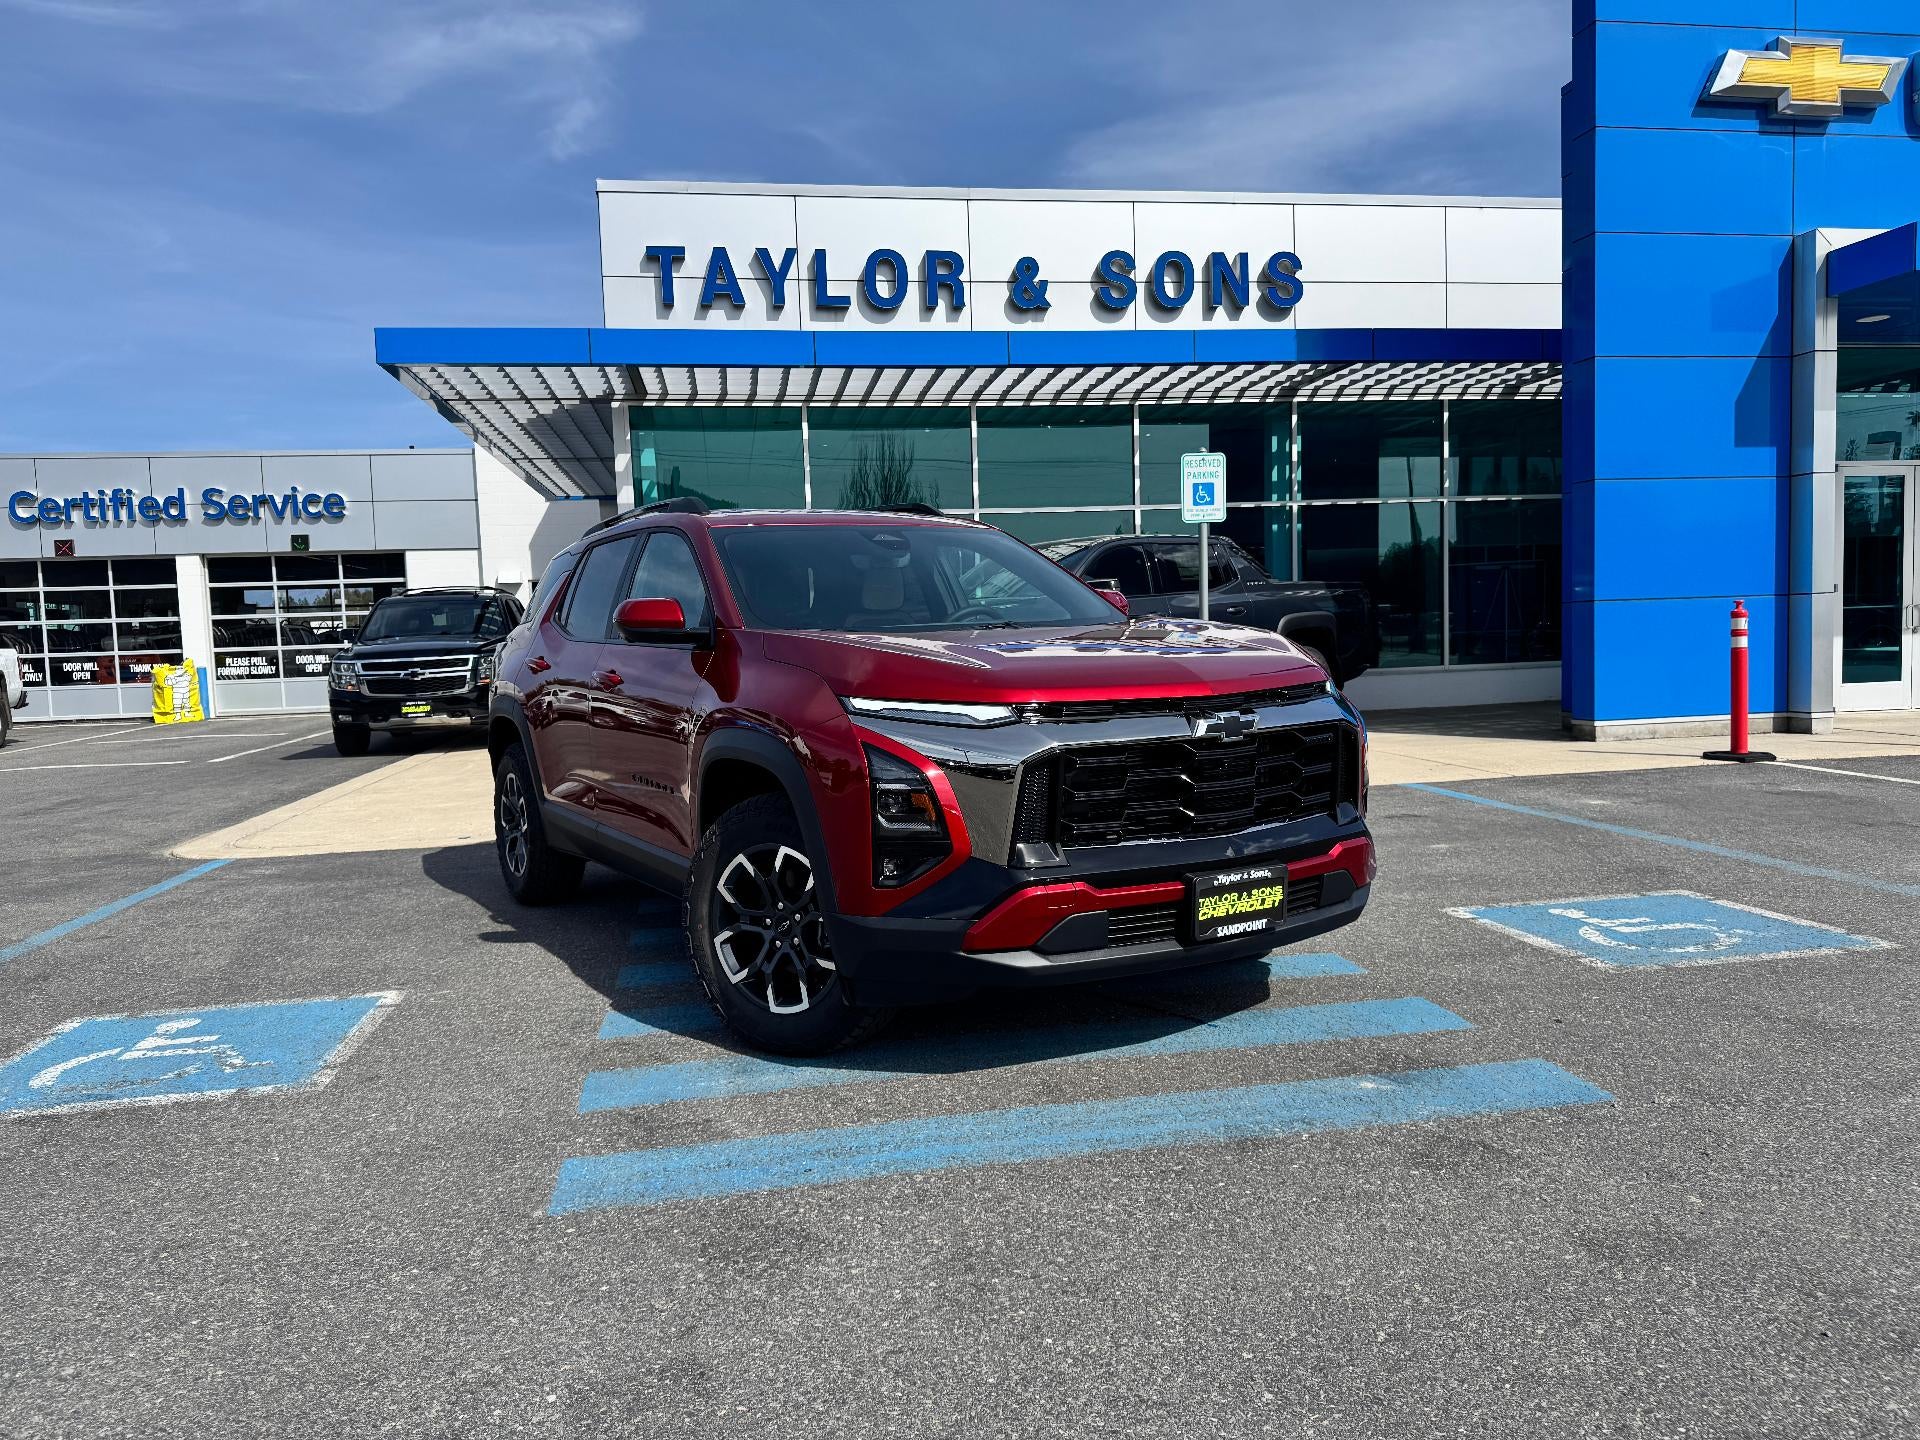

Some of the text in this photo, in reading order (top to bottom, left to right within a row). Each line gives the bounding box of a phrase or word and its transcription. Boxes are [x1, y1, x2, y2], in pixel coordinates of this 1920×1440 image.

[646, 246, 1304, 309] TAYLOR & SONS
[1185, 459, 1221, 468] RESERVED
[1187, 471, 1220, 479] PARKING
[8, 486, 346, 523] Certified Service
[226, 657, 268, 667] PLEASE PULL
[295, 654, 331, 664] DOOR WILL
[63, 662, 99, 672] DOOR WILL
[129, 664, 152, 673] THANK
[217, 665, 276, 676] FORWARD SLOWLY
[305, 664, 323, 673] OPEN
[72, 671, 91, 680] OPEN
[1199, 885, 1283, 908] TAYLOR & SONS
[1199, 894, 1283, 920] CHEVROLET
[1217, 918, 1267, 937] SANDPOINT
